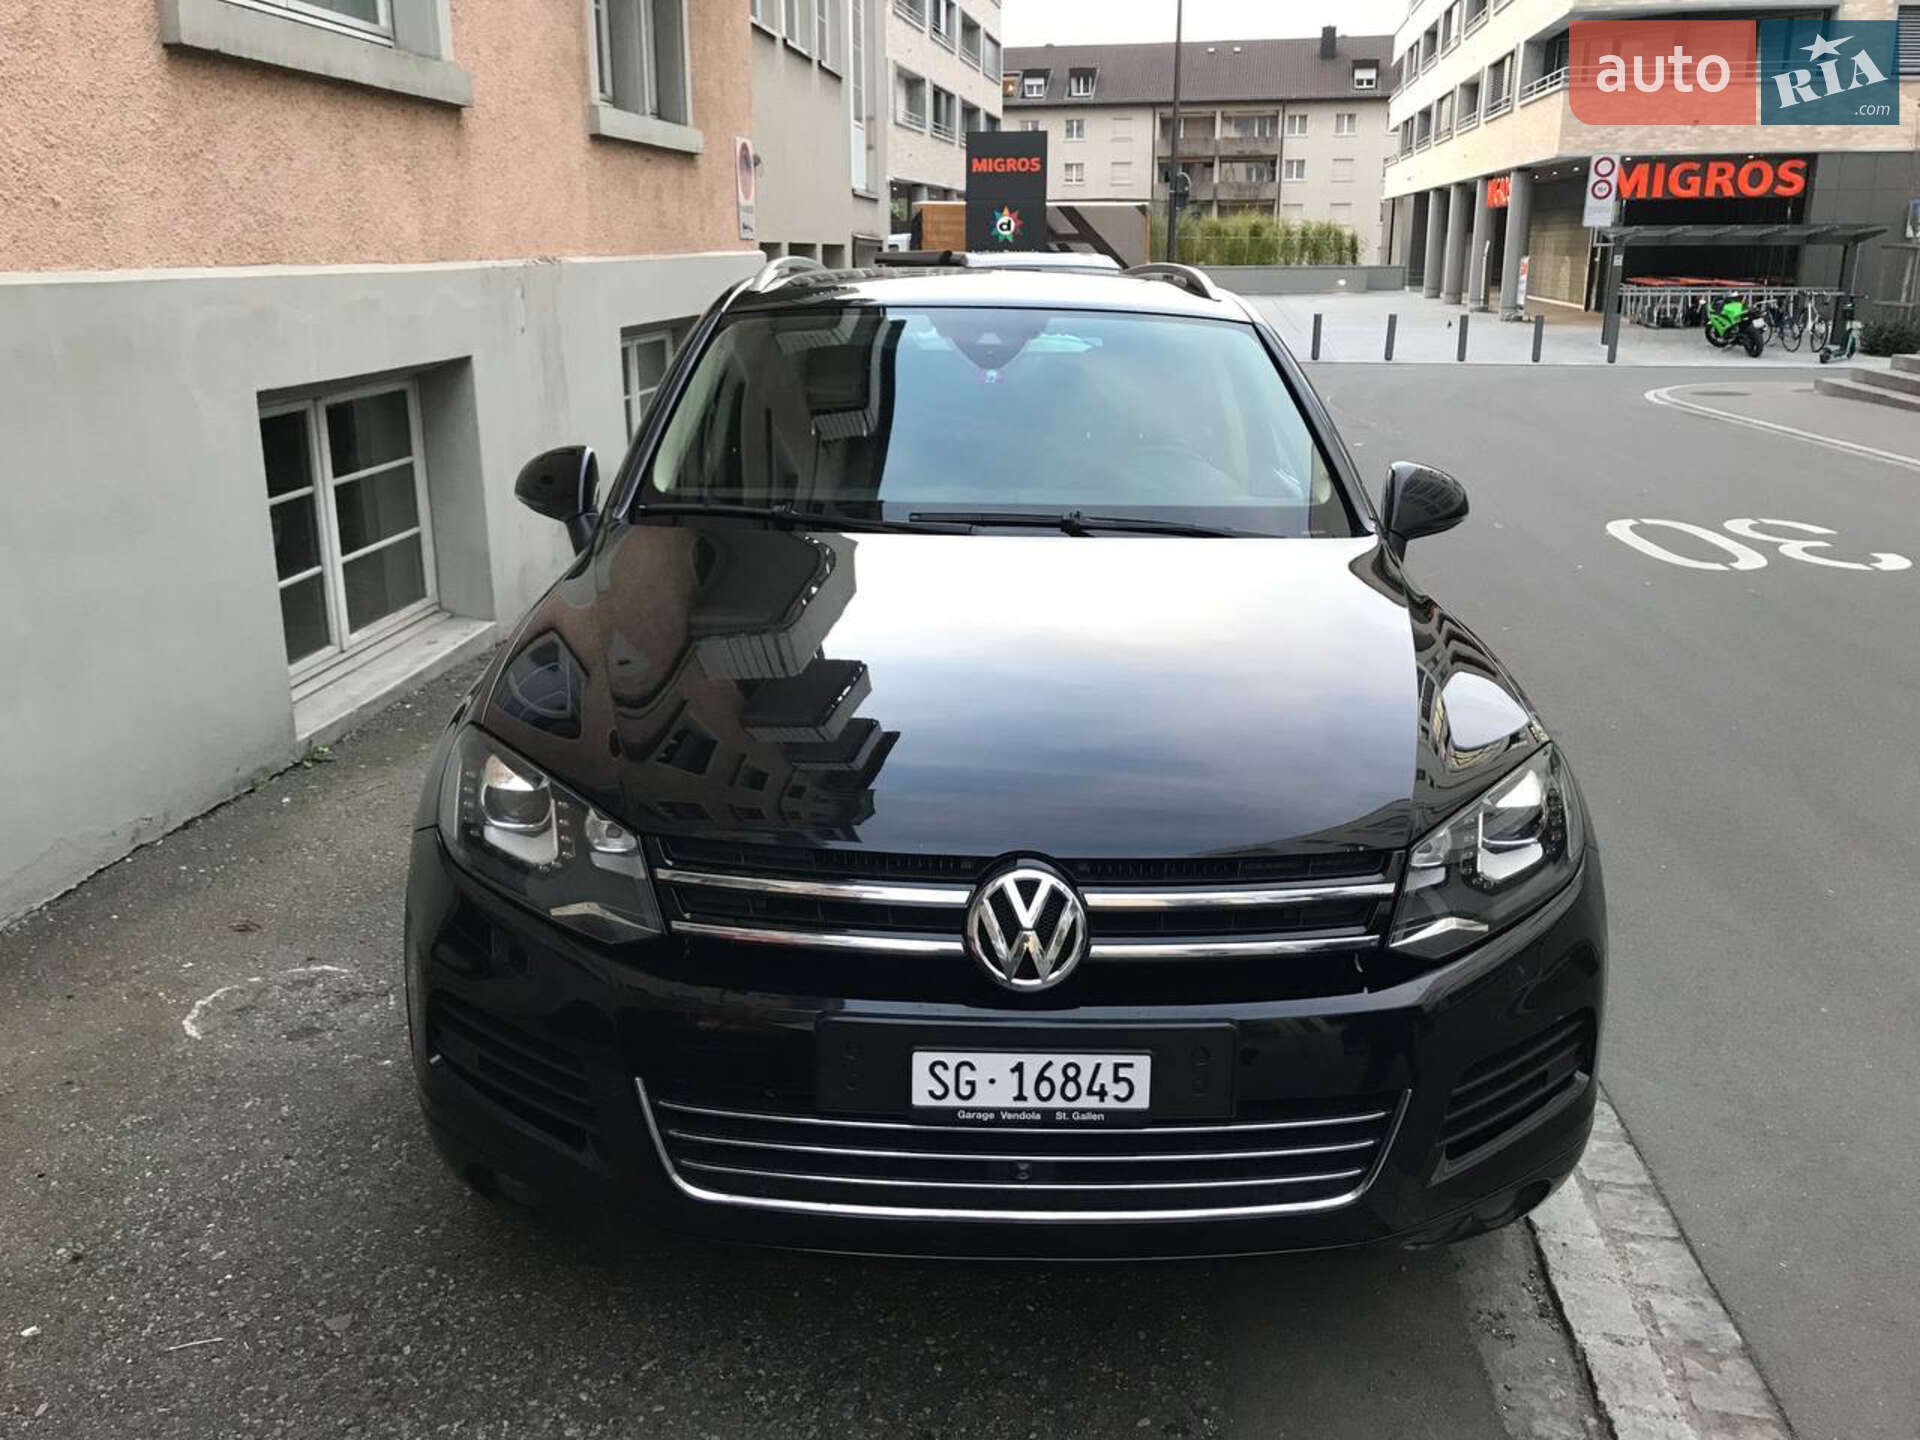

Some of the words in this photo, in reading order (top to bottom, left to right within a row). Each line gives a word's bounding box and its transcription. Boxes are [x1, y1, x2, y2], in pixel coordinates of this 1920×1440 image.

[971, 157, 1042, 173] MIGROS
[1617, 157, 1808, 199] MIGROS
[957, 1109, 995, 1121] Garage
[1001, 1110, 1041, 1121] Vendola
[1055, 1111, 1069, 1121] St.
[1072, 1111, 1105, 1121] Gallen
